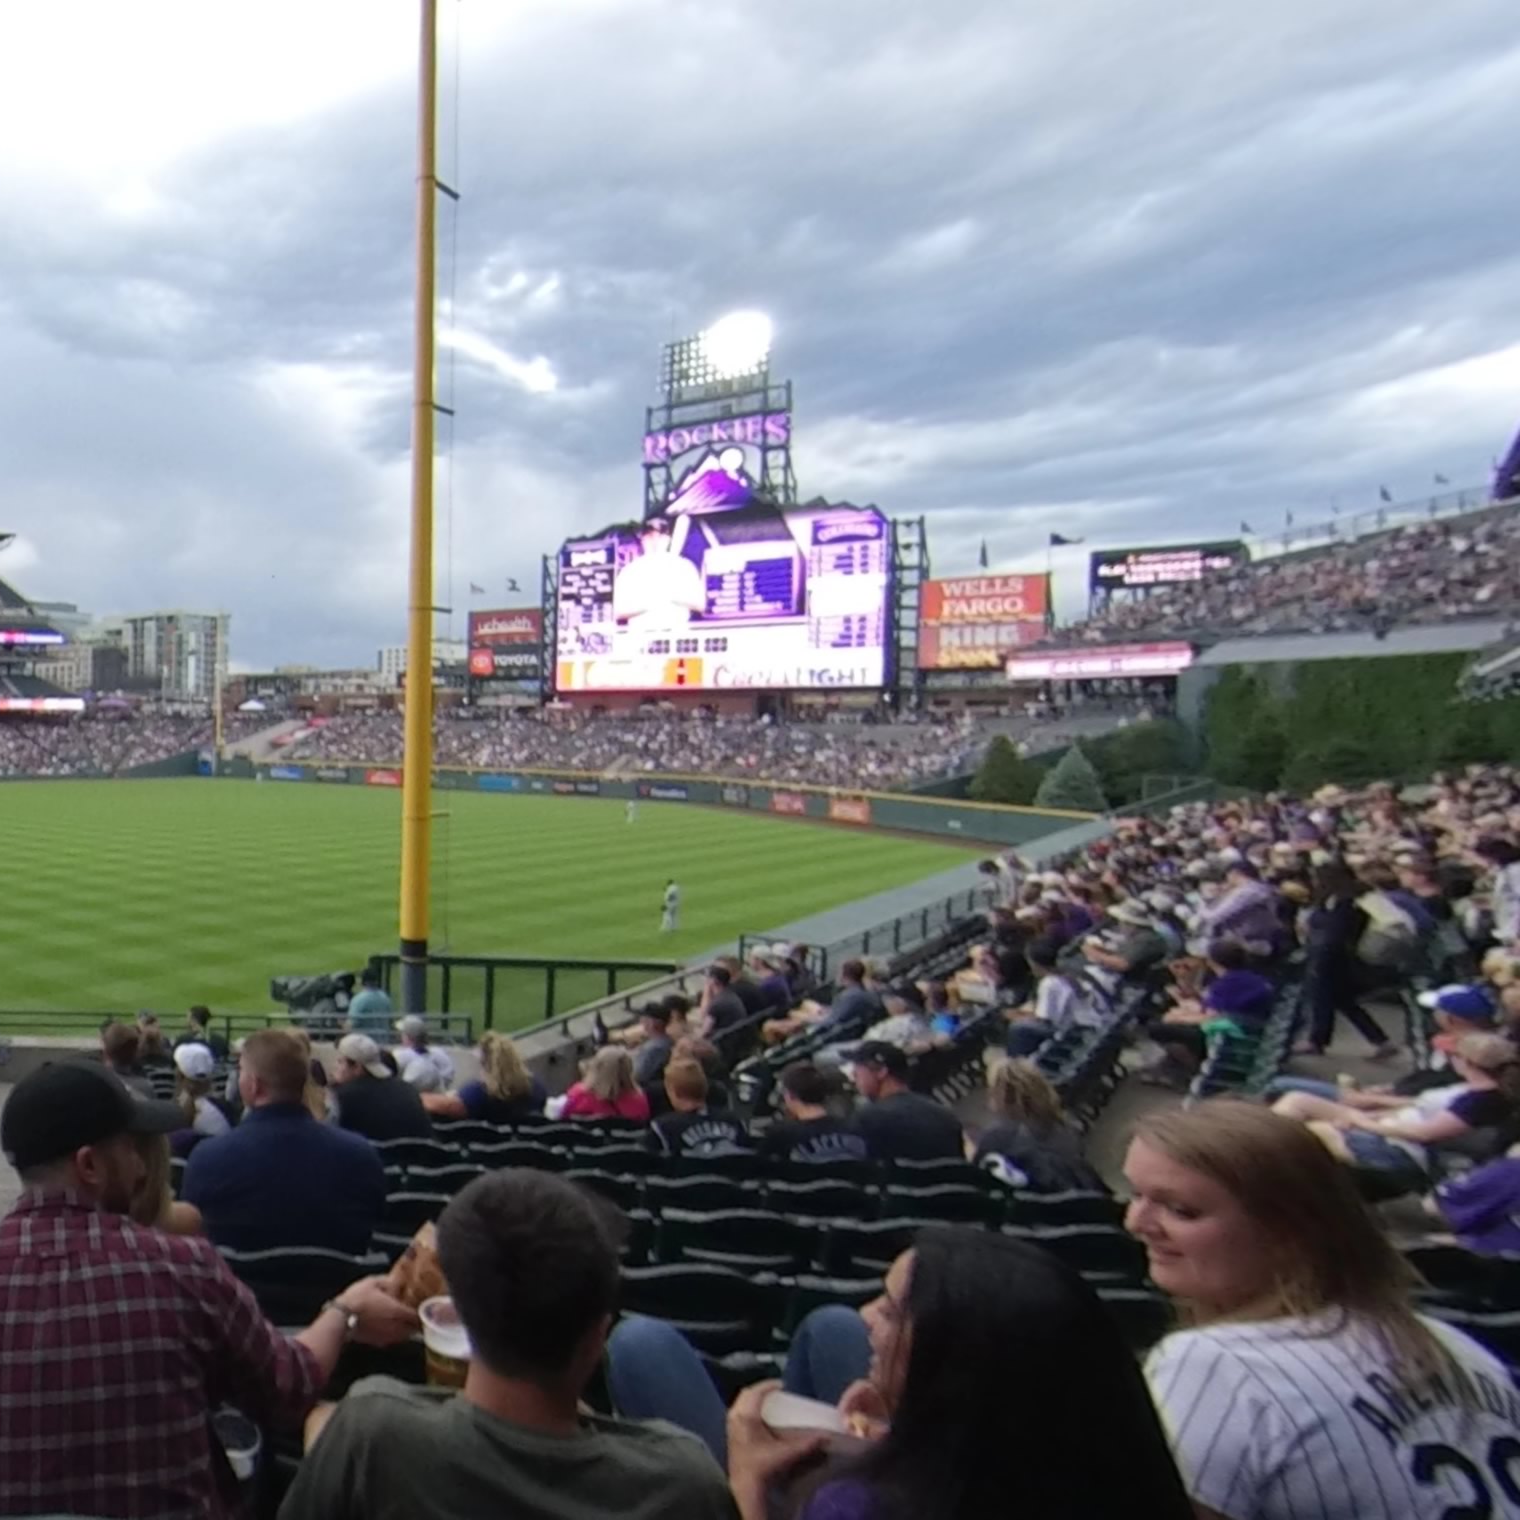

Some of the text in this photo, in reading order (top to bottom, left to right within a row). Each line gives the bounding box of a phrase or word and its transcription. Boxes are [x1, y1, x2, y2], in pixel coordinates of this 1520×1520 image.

[643, 412, 788, 464] ROCKIES
[941, 577, 1024, 598] WELLS
[941, 597, 1024, 616] FARGO
[493, 654, 538, 667] TOYOTA
